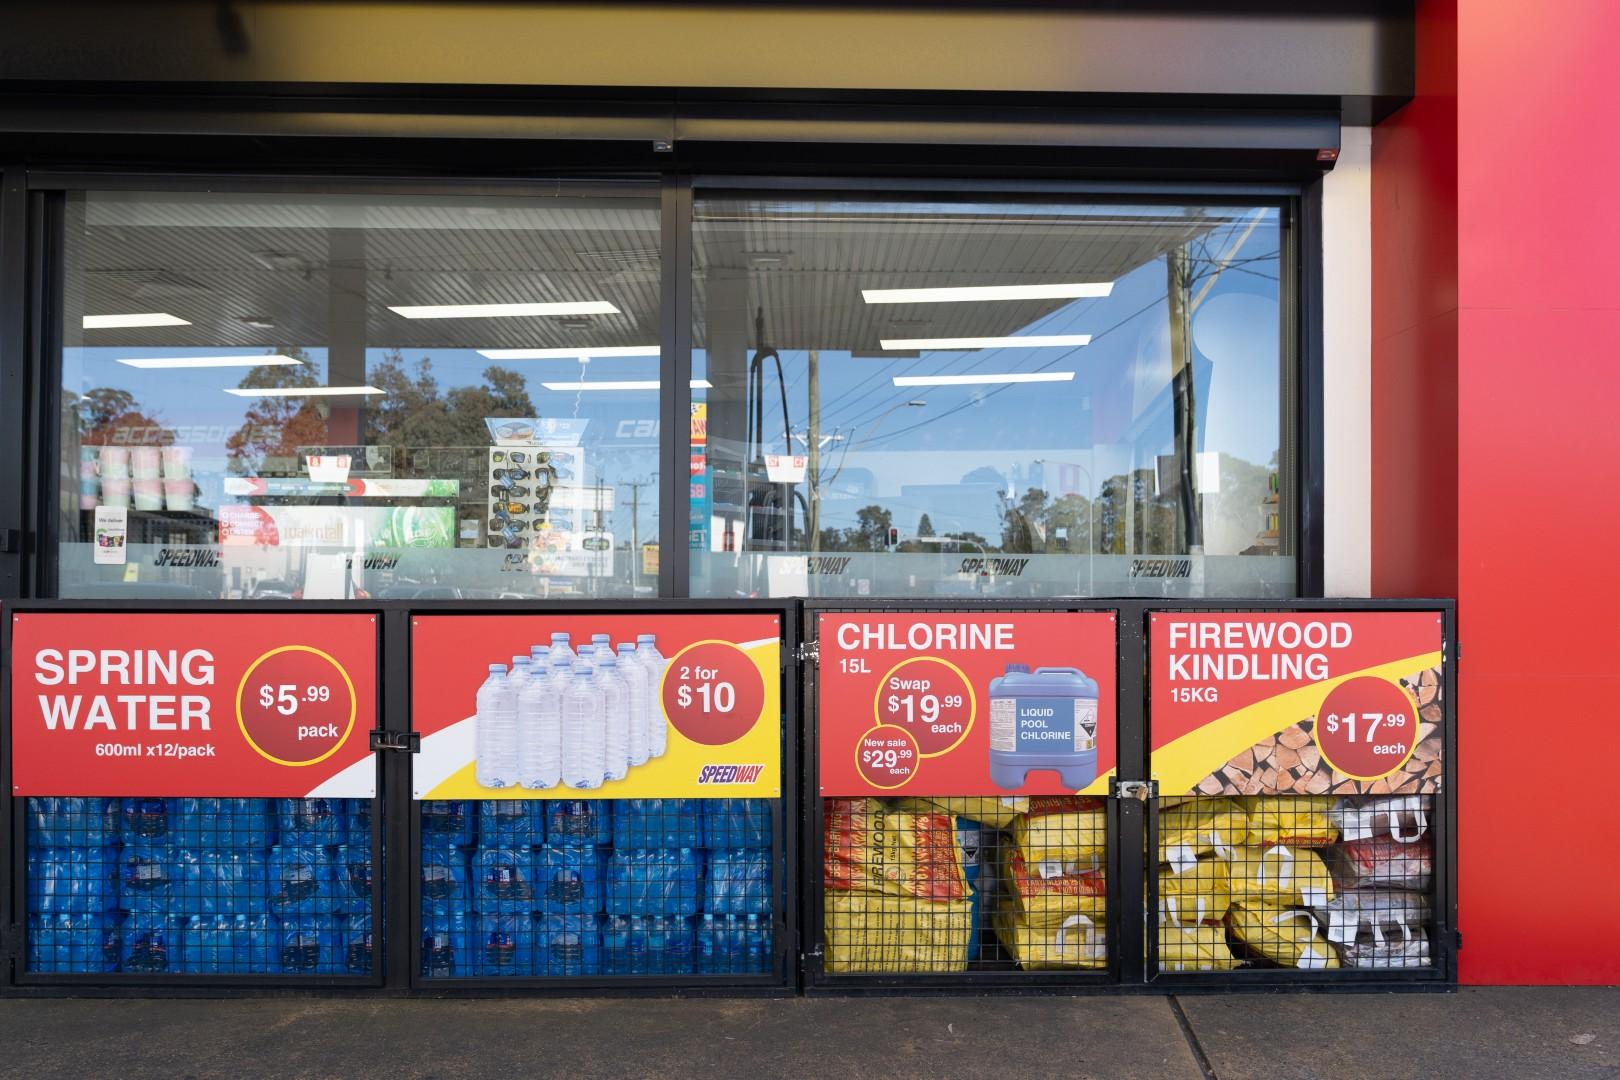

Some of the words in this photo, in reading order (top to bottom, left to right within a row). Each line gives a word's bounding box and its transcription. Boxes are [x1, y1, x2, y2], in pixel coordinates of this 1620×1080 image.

[836, 622, 1015, 651] CHLORINE
[1168, 621, 1353, 649] FIREWOOD
[34, 648, 216, 686] SPRING
[680, 667, 690, 680] 2
[694, 666, 718, 680] for
[839, 658, 872, 674] 15L
[1168, 653, 1329, 681] KINDLING
[889, 677, 931, 693] Swap
[259, 683, 331, 716] $5.99
[677, 681, 736, 714] $10
[1170, 686, 1219, 703] 15KG
[38, 695, 212, 731] WATER
[888, 694, 963, 723] $19.99
[1020, 708, 1054, 717] LIQUID
[298, 723, 339, 740] pack
[931, 721, 962, 734] each
[1020, 719, 1048, 728] POOL
[1326, 712, 1406, 743] $17.99
[864, 738, 885, 748] New
[887, 738, 907, 748] sale
[1020, 731, 1071, 740] CHLORINE
[95, 743, 142, 757] 600ml
[146, 743, 216, 759] x12/pack
[1373, 742, 1406, 755] each
[863, 750, 912, 768] $29.99
[698, 765, 764, 784] SPEEDWAY
[889, 766, 910, 775] each
[871, 810, 886, 887] FIREWOOD
